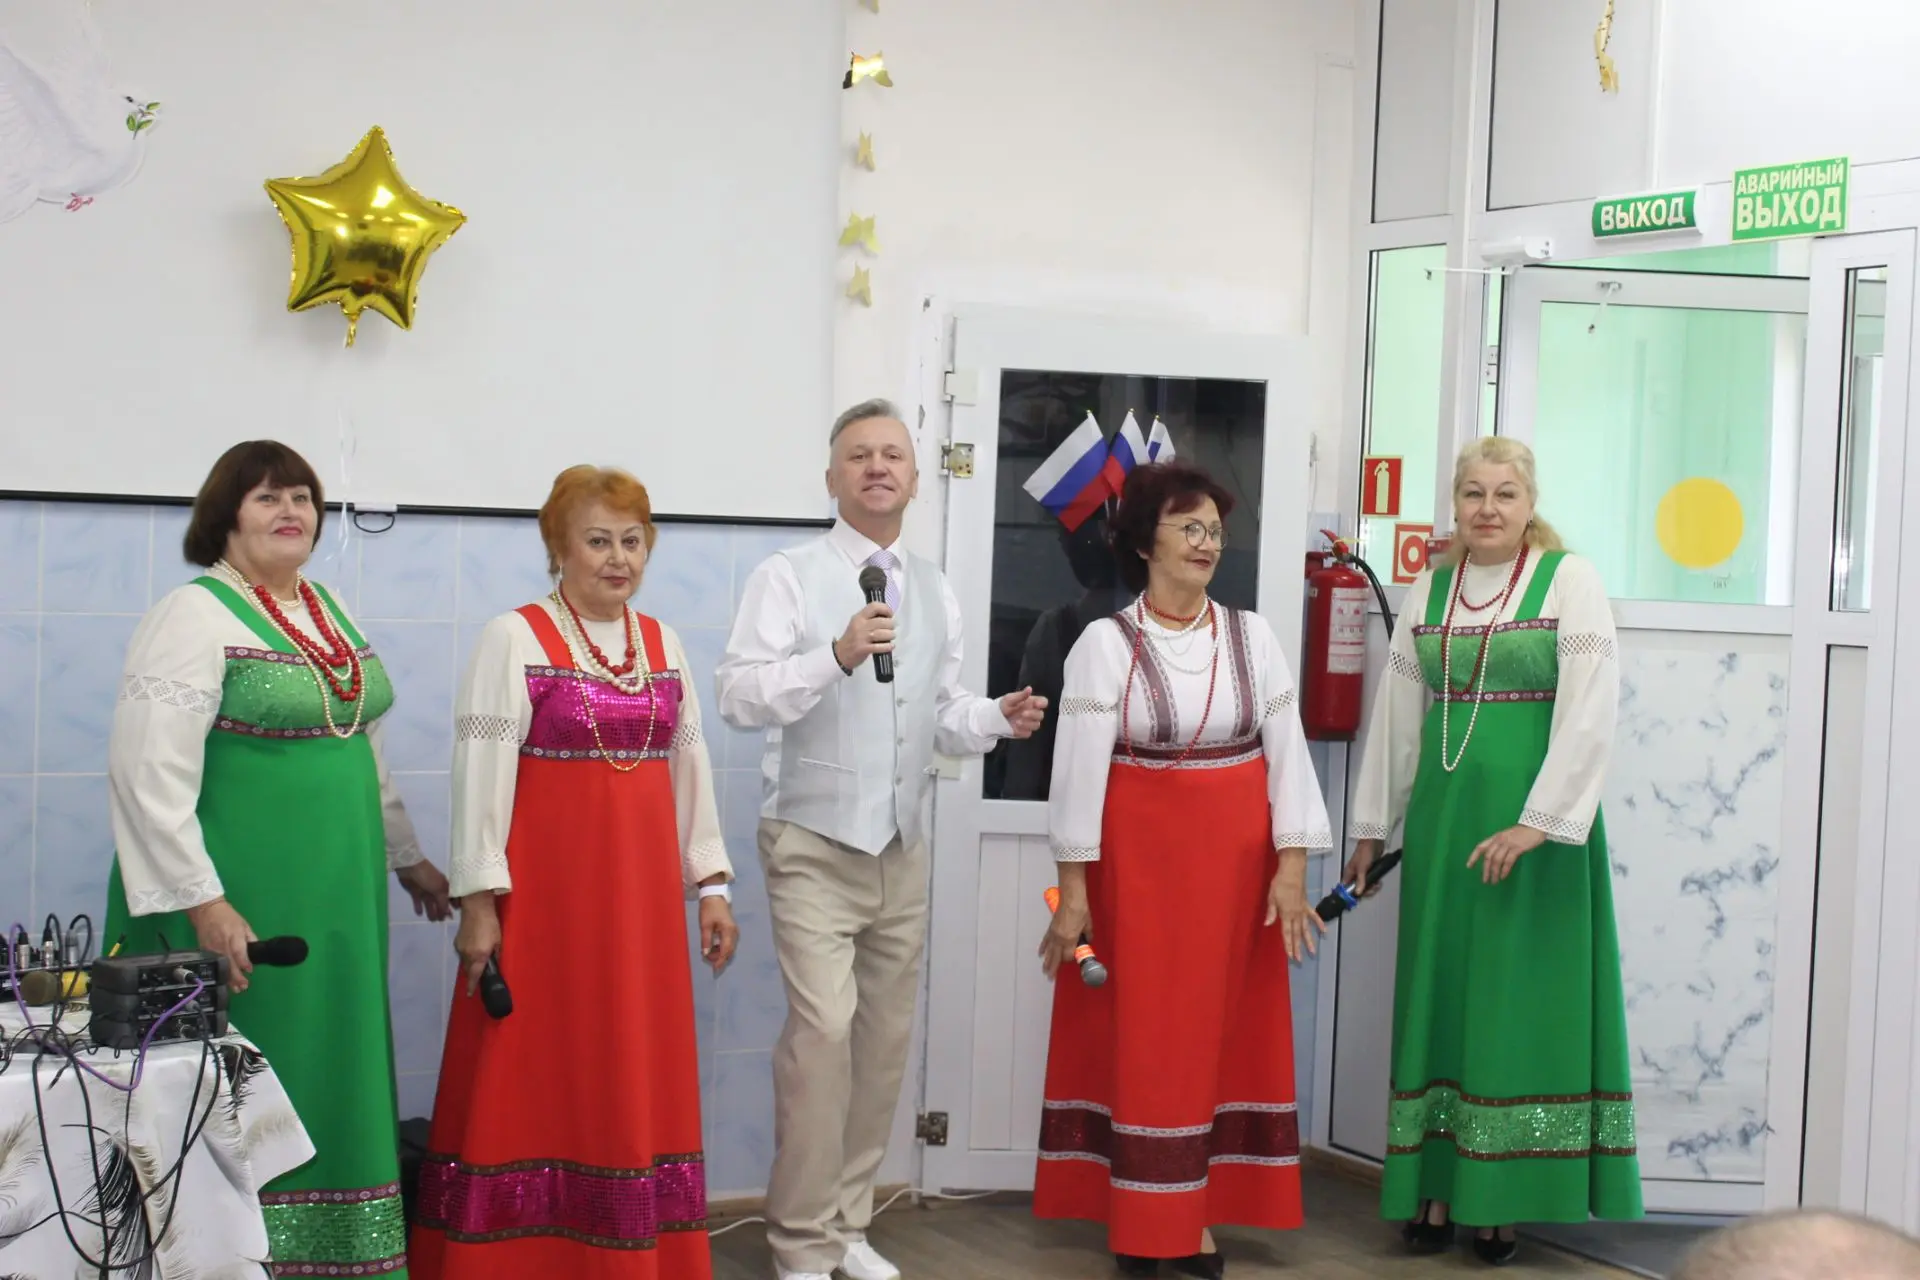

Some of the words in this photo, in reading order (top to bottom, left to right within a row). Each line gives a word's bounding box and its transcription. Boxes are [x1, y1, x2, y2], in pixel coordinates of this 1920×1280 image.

[1736, 159, 1844, 196] АВАРИЙНЫЙ
[1600, 197, 1687, 231] ВЫХОД
[1736, 186, 1843, 232] ВЫХОД
